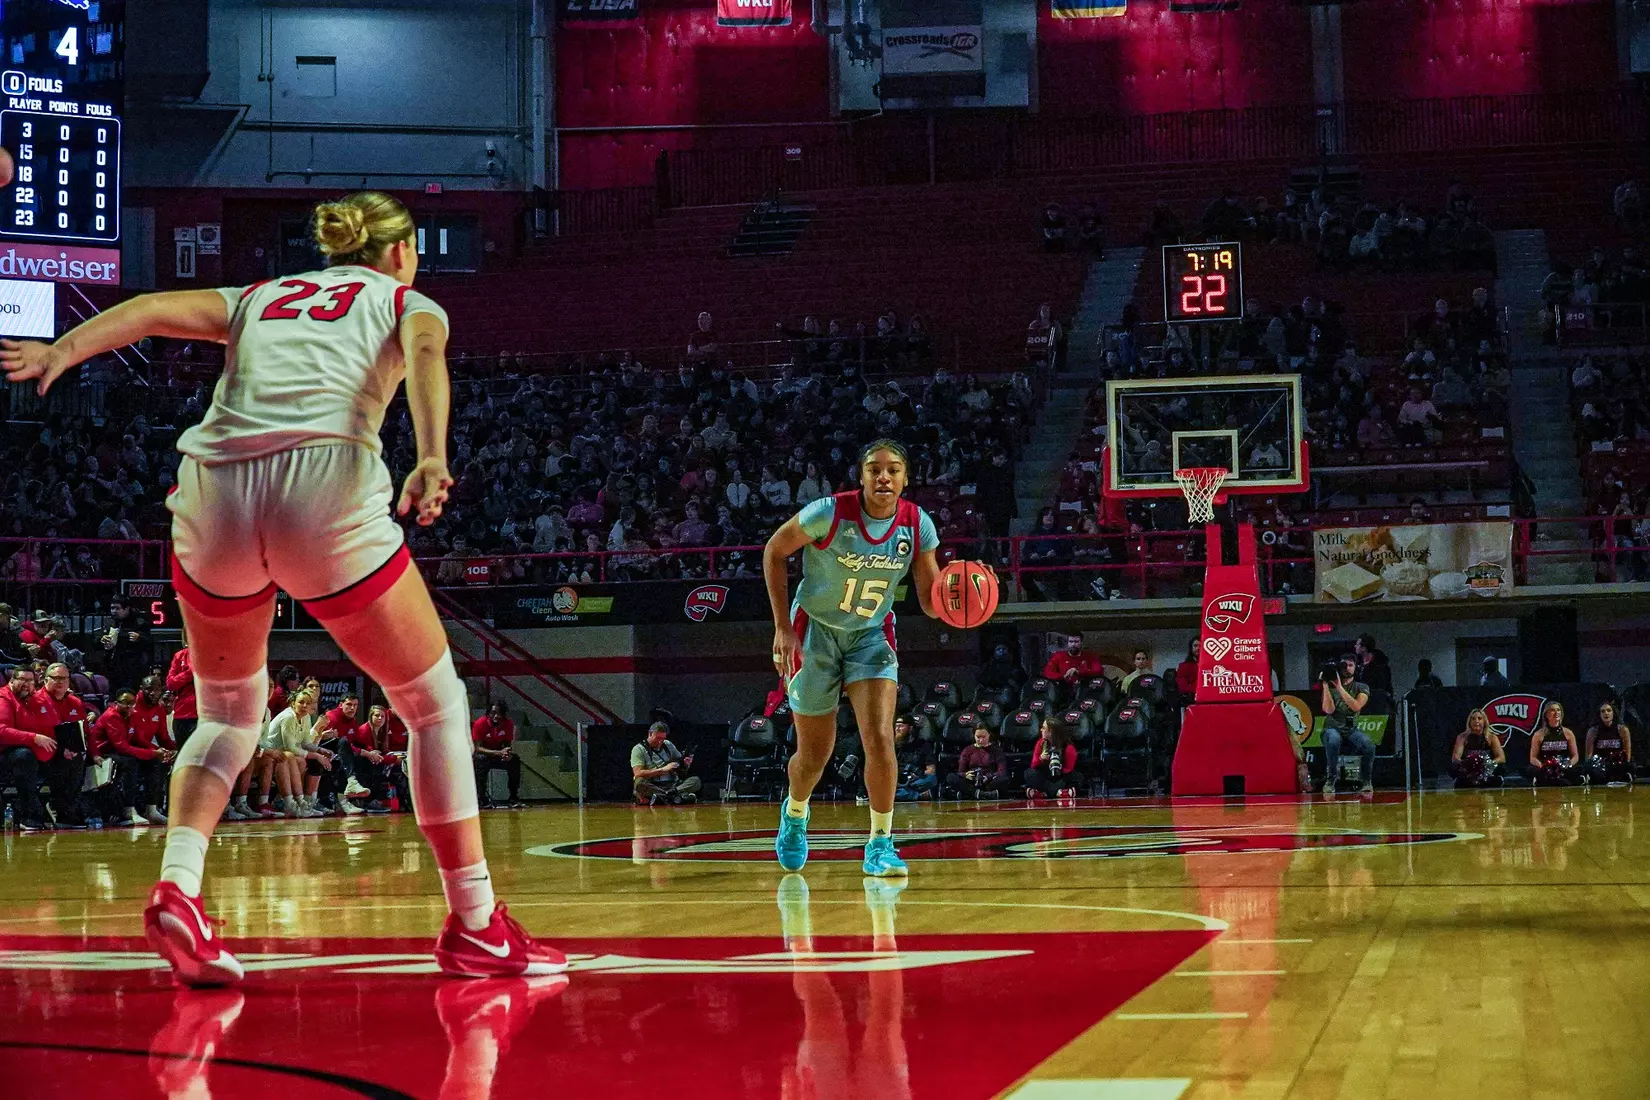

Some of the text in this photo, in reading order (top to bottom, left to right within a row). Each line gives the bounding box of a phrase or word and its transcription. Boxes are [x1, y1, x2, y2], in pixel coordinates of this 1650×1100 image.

[56, 26, 79, 65] 4
[10, 76, 63, 93] 0 FOULS
[9, 97, 112, 116] PLAYER POINTS FOULS
[22, 122, 107, 143] 3 0 0
[20, 144, 106, 166] 15 0 0
[19, 166, 106, 188] 18 0 0
[15, 187, 105, 209] 22 0 0
[15, 209, 105, 231] 23 0 0
[1187, 251, 1232, 271] 7:19
[259, 279, 366, 322] 23
[1182, 274, 1225, 312] 22
[837, 552, 865, 572] Lady
[1319, 547, 1432, 562] Natural Goodness
[467, 566, 489, 575] 108
[128, 583, 164, 597] WKU
[697, 591, 719, 602] WKU
[839, 577, 889, 618] 15
[150, 601, 164, 625] 5
[531, 606, 553, 615] Clean
[1219, 600, 1243, 612] WKU
[545, 614, 561, 622] Auto
[1233, 637, 1262, 645] Graves
[1233, 645, 1262, 653] Gilbert
[1233, 652, 1255, 660] Clinic
[1219, 686, 1252, 694] MOVING
[1494, 703, 1529, 719] WKU
